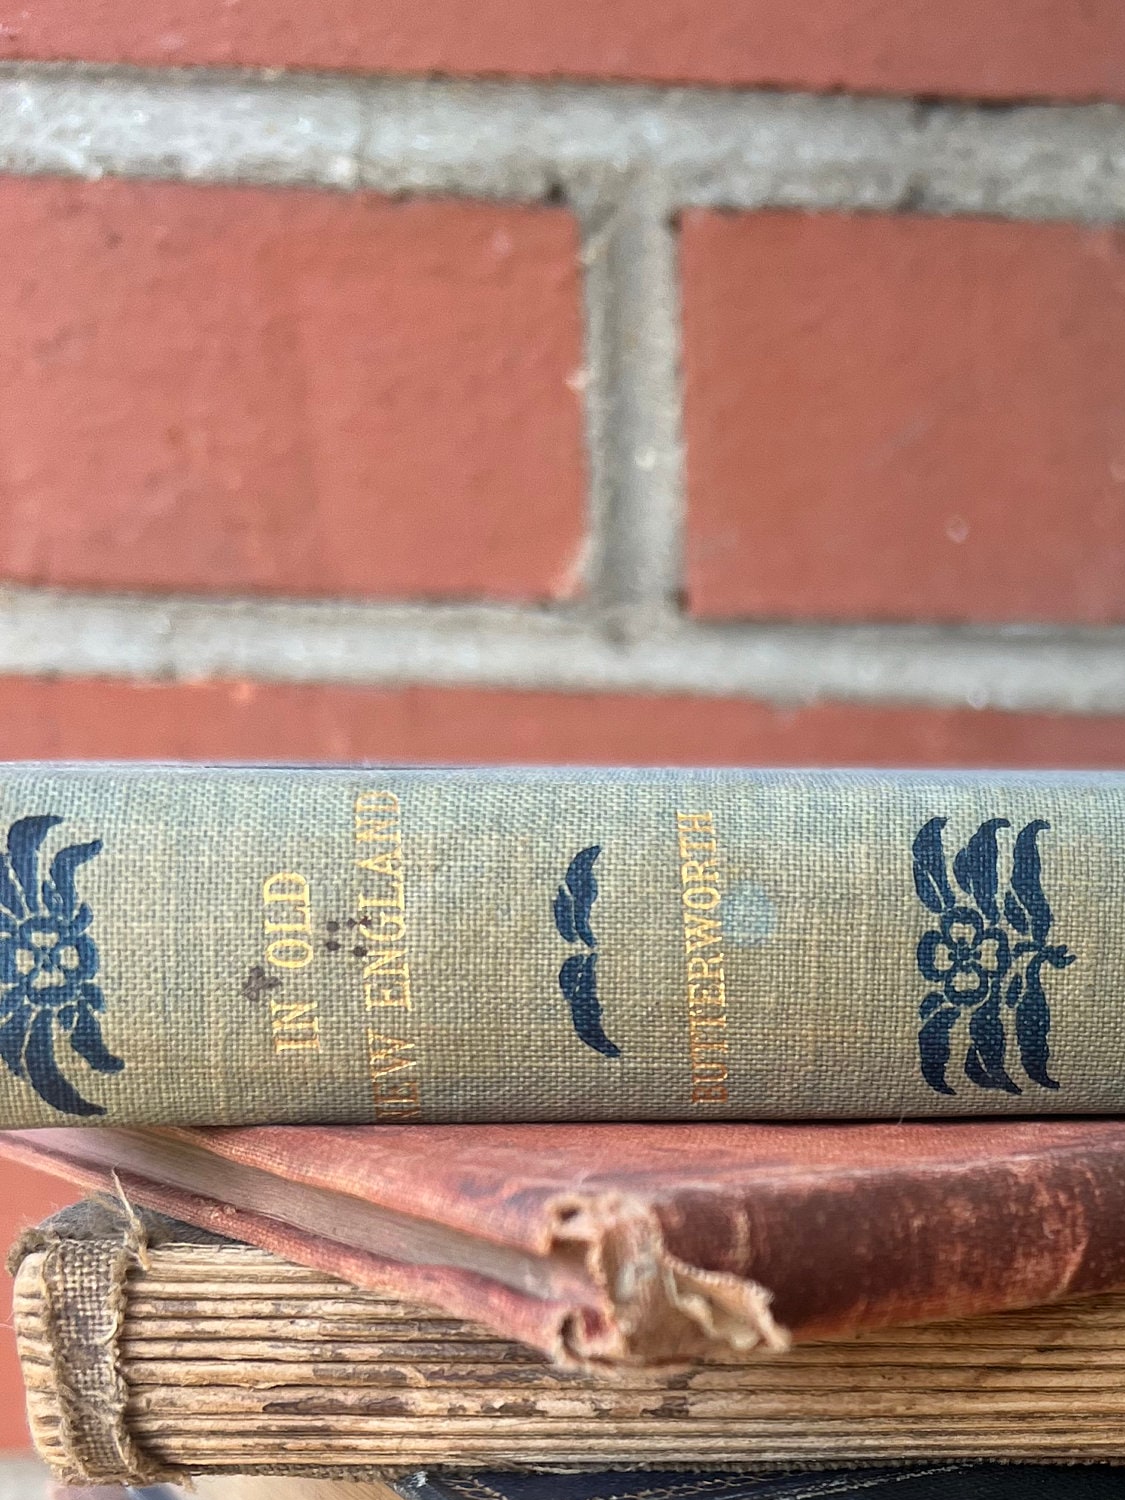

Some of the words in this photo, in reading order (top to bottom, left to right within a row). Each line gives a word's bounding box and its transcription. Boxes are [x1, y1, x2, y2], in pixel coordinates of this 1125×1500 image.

[262, 870, 315, 969] OLD
[355, 789, 413, 1011] ENGLAND
[677, 810, 729, 1103] BUTTERWORTH
[269, 999, 323, 1053] IN
